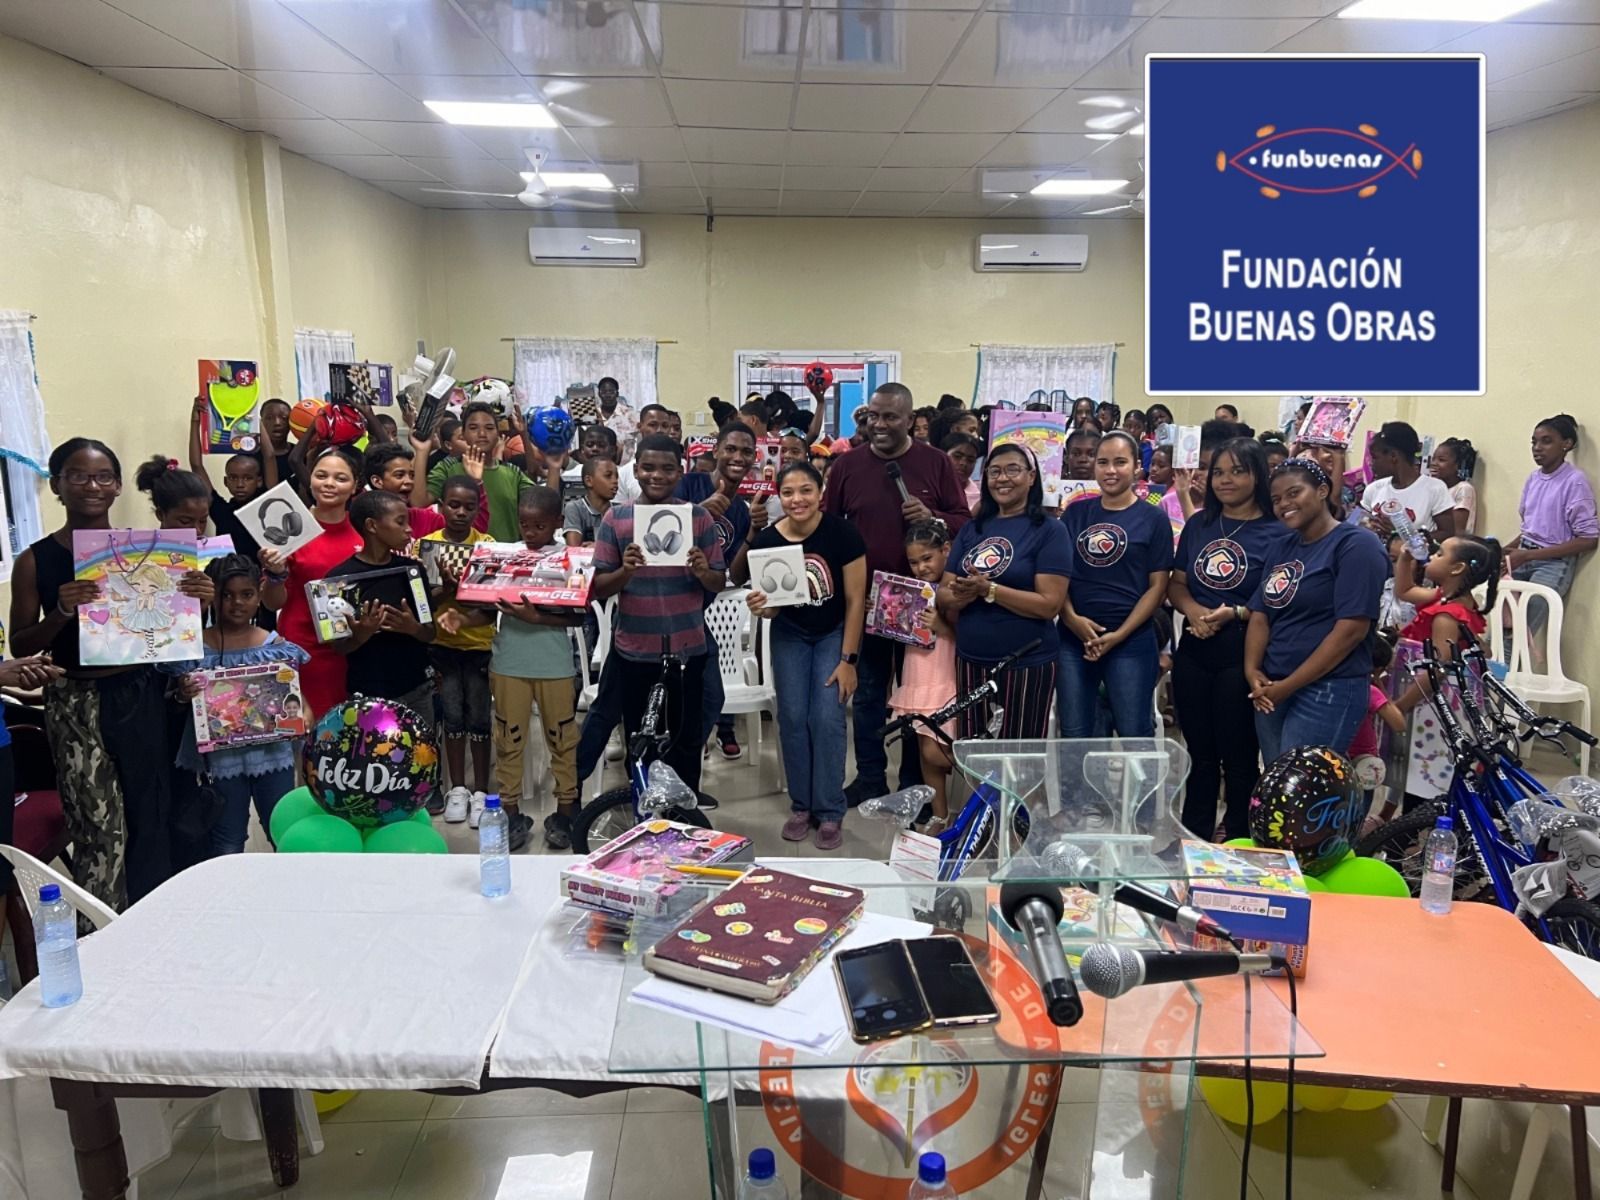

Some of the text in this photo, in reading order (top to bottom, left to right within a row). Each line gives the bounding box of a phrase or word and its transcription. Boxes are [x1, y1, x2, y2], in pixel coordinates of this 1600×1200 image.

[318, 755, 412, 794] Feliz Día
[750, 885, 829, 909] SANTA BIBLIA
